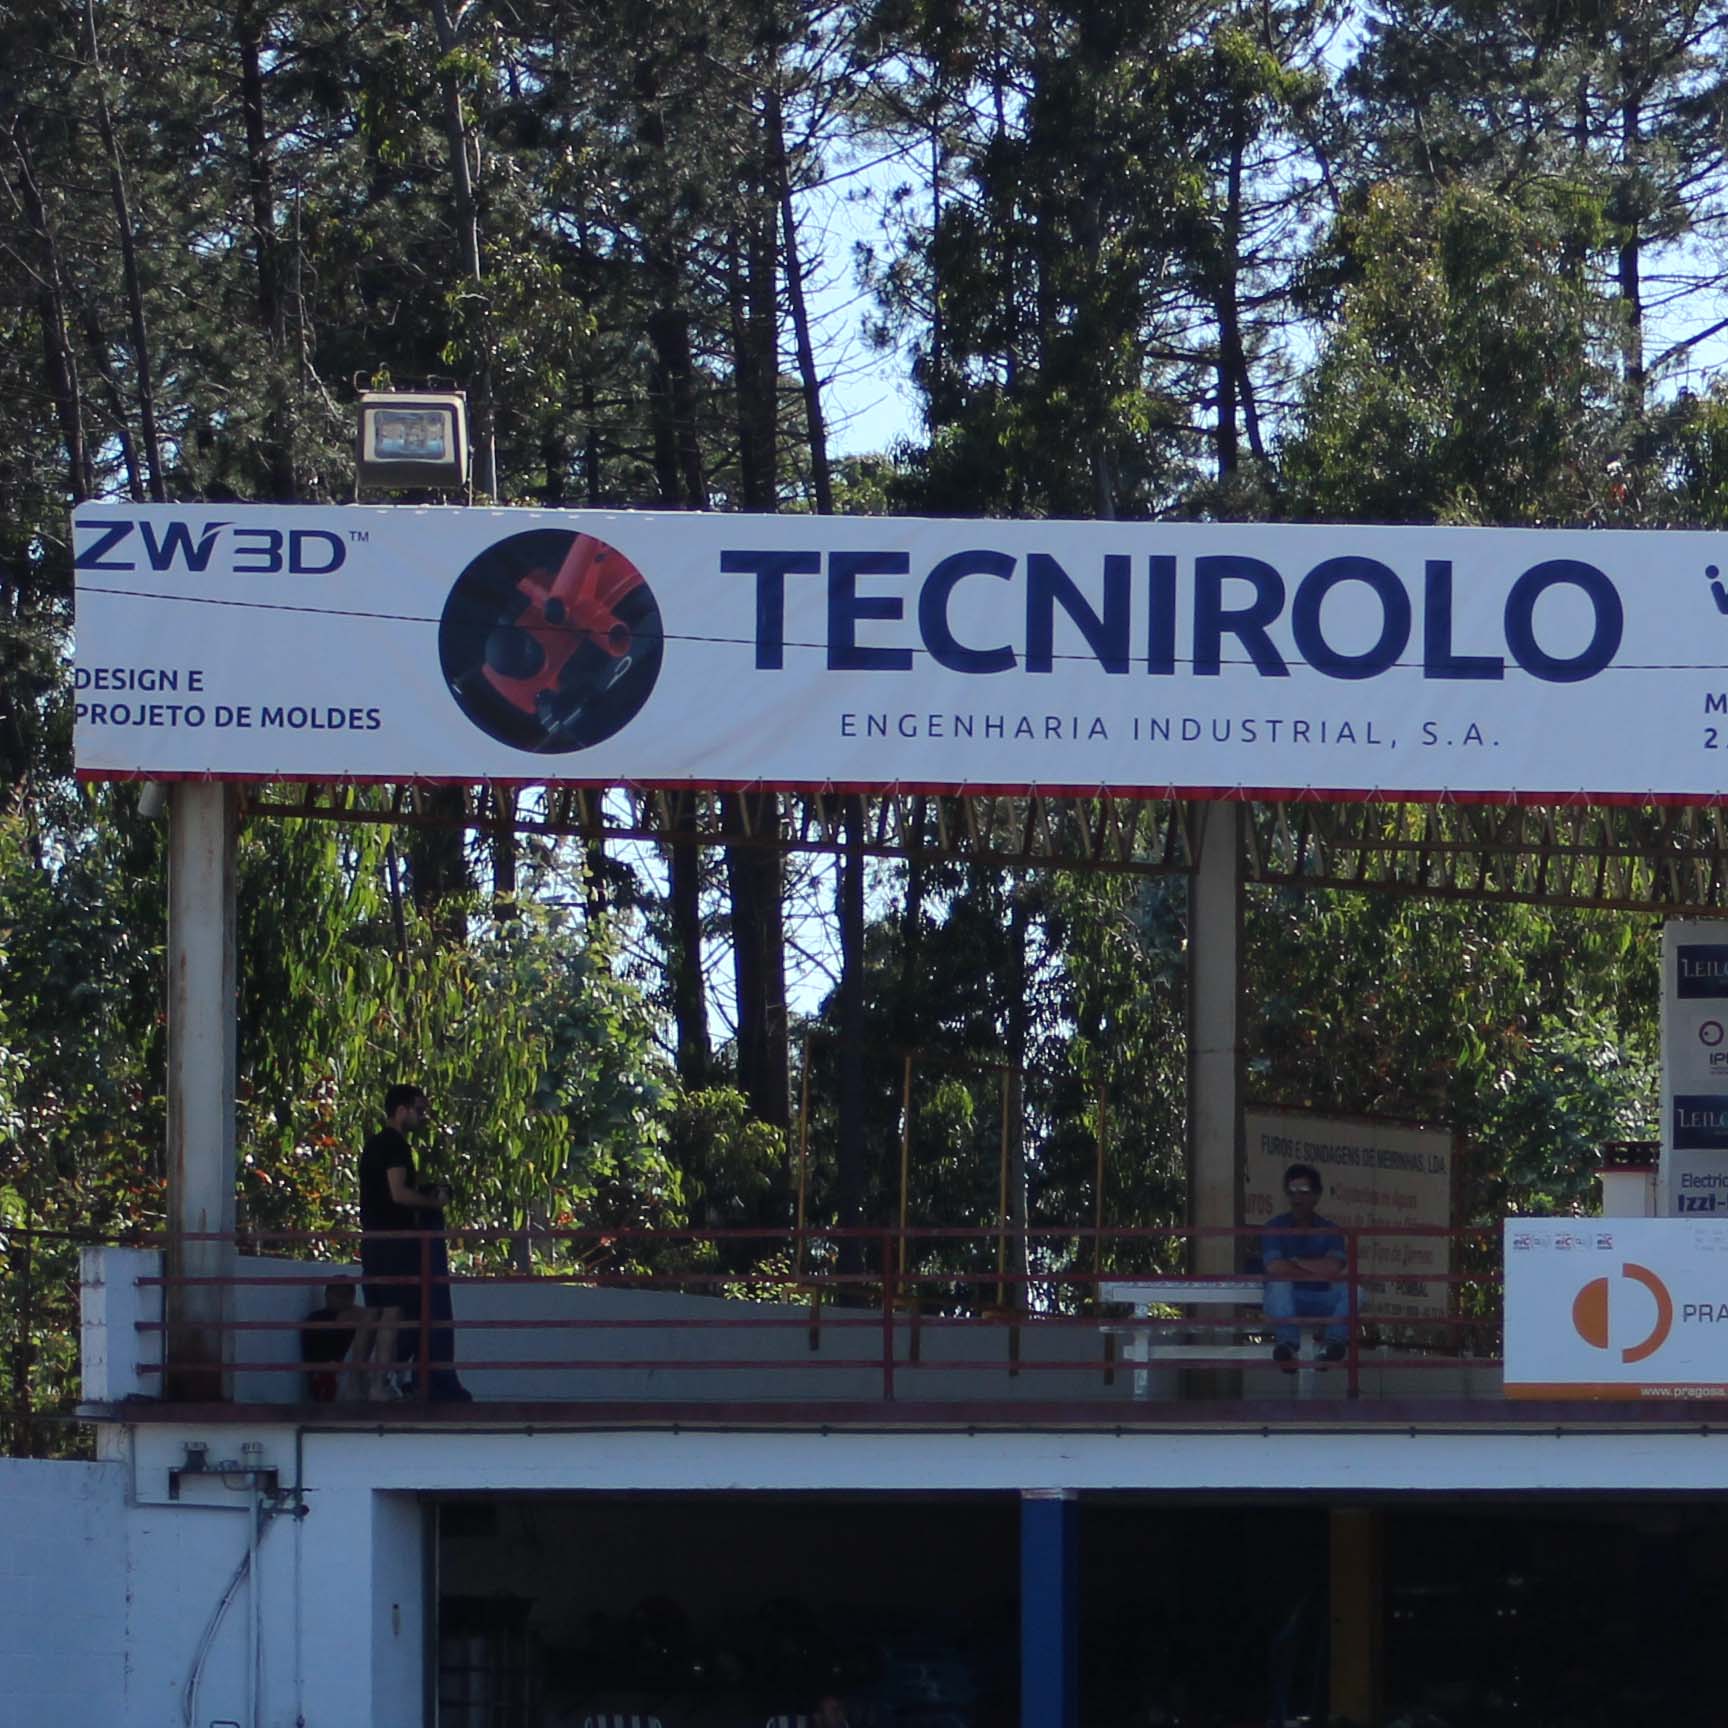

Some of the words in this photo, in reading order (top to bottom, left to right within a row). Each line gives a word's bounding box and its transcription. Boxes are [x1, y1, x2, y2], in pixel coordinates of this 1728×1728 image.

[719, 549, 1625, 684] TECNIROLO
[75, 667, 178, 691] DESIGN
[188, 670, 204, 692] E
[75, 703, 206, 727] PROJETO
[215, 705, 252, 728] DE
[260, 706, 381, 730] MOLDES
[841, 713, 1108, 742] ENGENHARIA
[1134, 717, 1396, 748] INDUSTRIAL,
[1422, 721, 1502, 746] S.A.
[1704, 727, 1718, 749] 2
[1681, 1172, 1728, 1188] Electric
